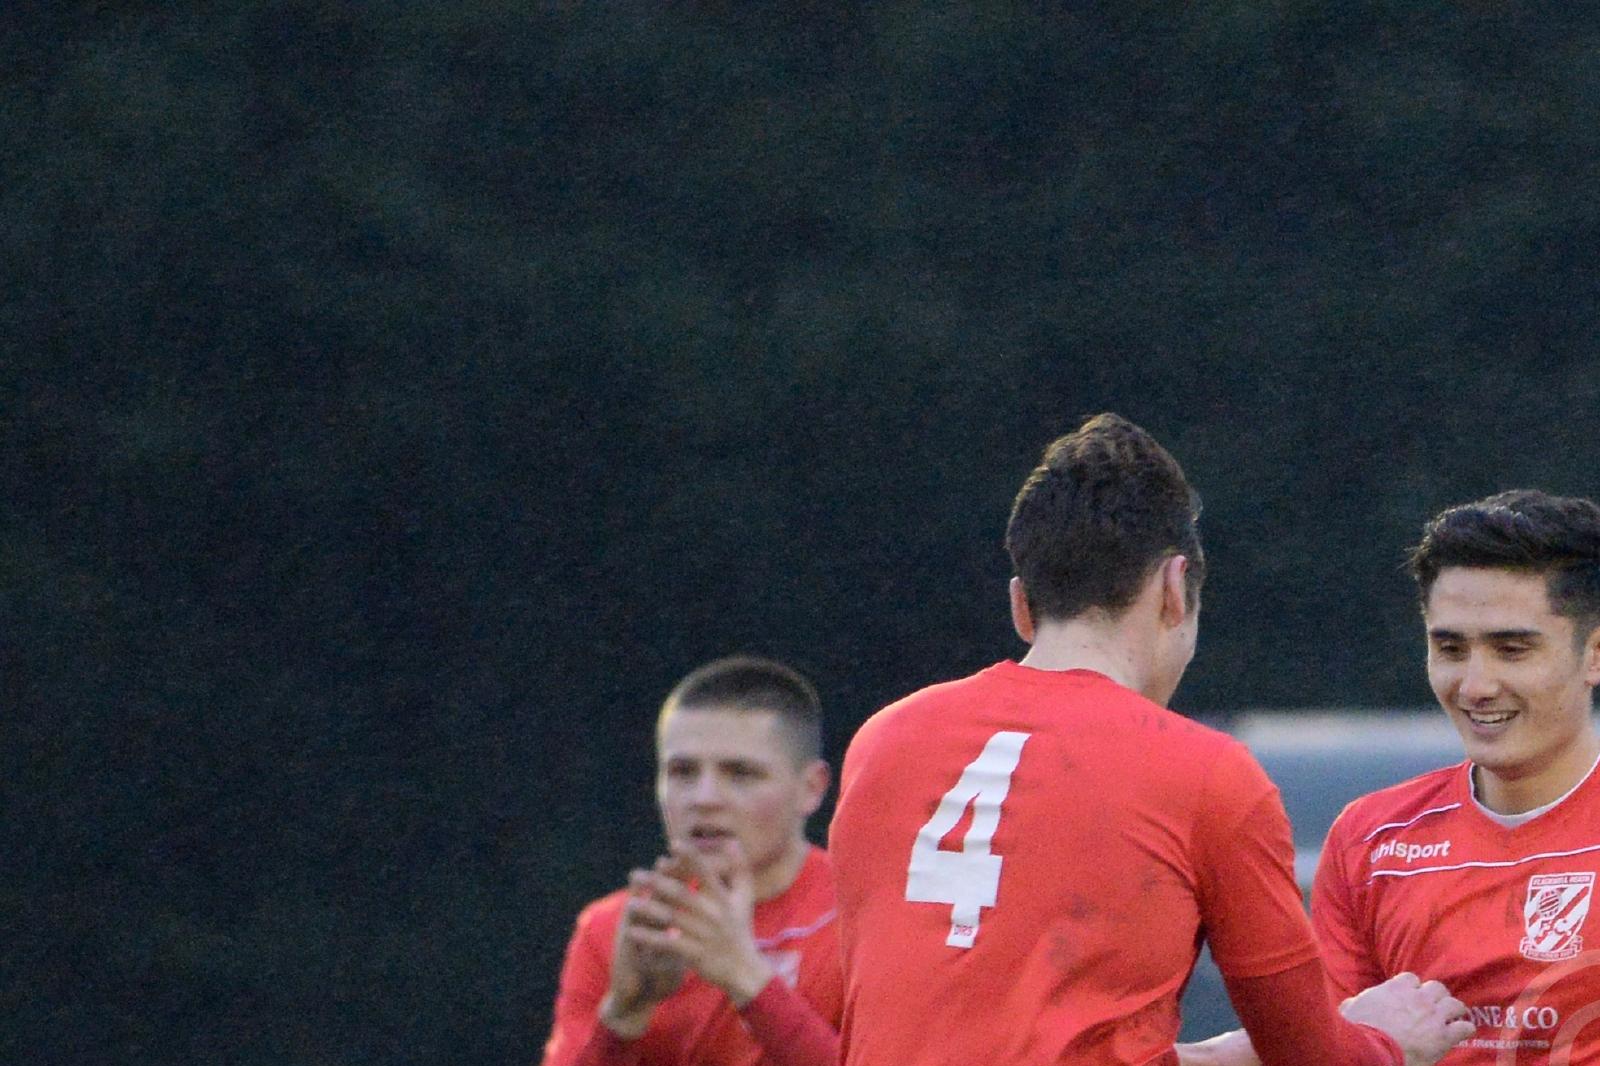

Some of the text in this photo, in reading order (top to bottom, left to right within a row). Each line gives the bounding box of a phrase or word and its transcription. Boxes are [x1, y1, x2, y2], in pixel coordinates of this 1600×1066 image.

[906, 731, 1032, 948] 4
[1505, 1005, 1518, 1029] &
[1522, 1006, 1558, 1029] CO
